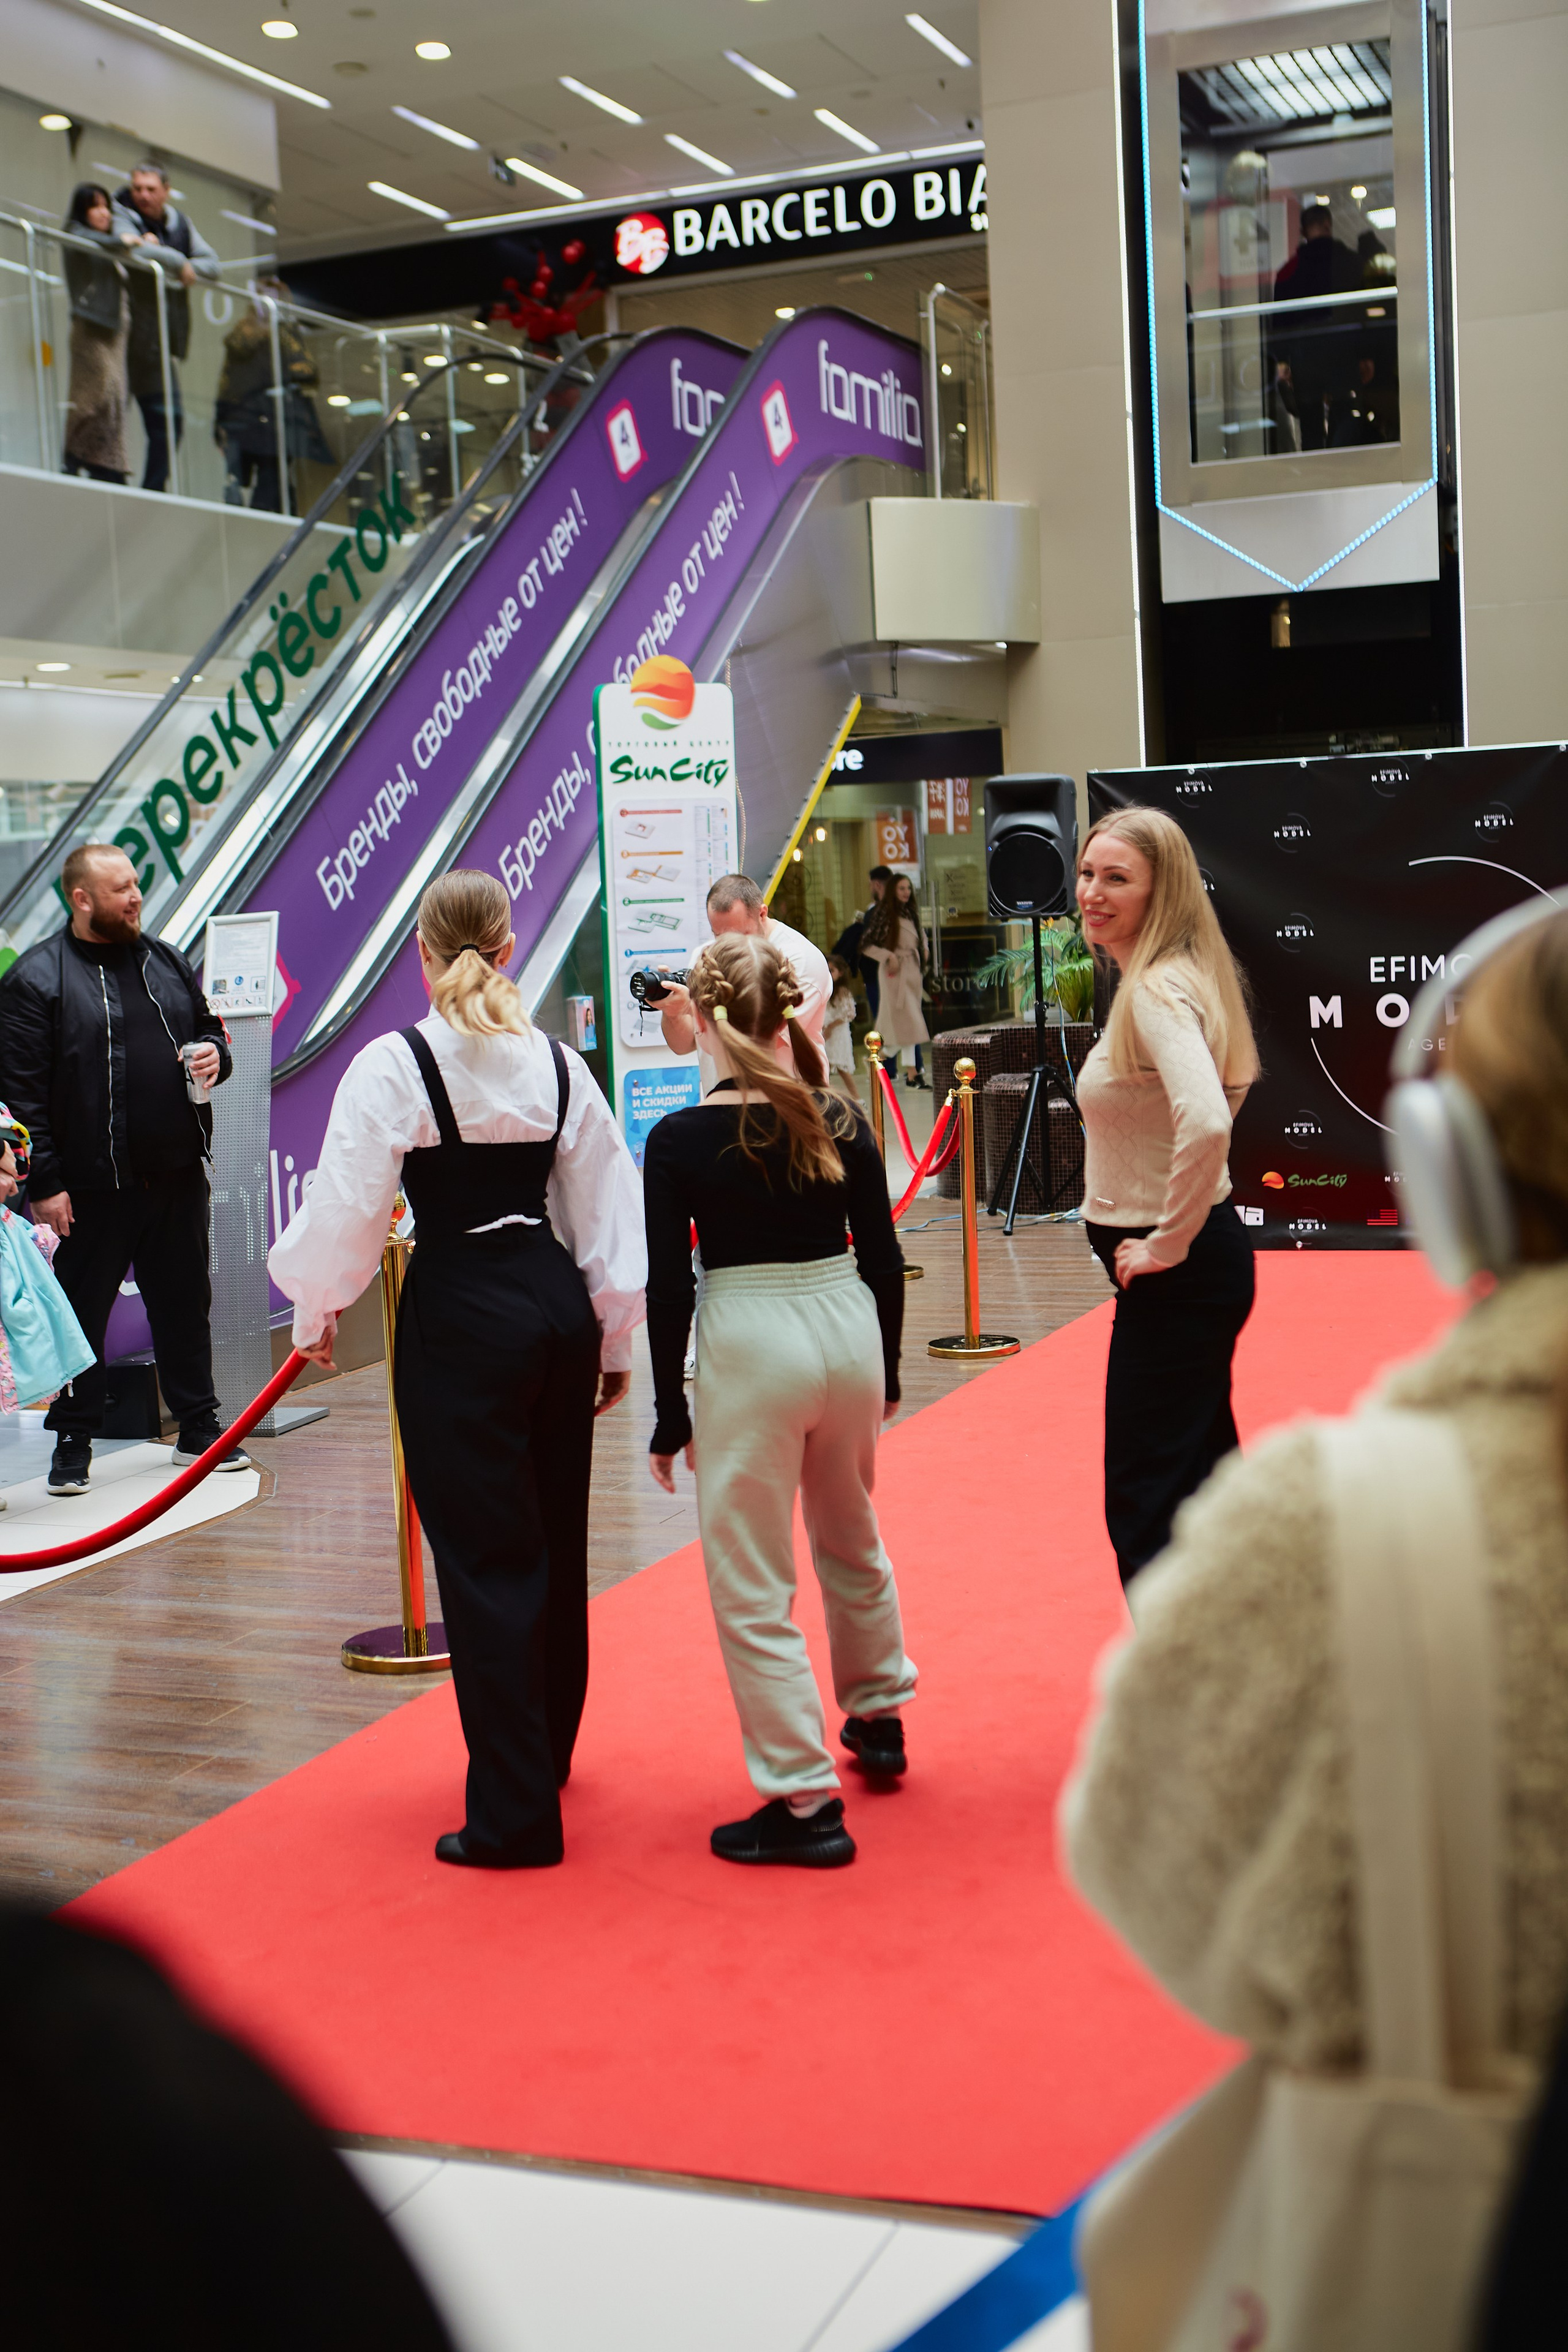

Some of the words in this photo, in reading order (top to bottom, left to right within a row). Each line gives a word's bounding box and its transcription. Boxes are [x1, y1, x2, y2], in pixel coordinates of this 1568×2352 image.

[673, 179, 895, 256] BARCELO
[818, 339, 923, 448] familia
[53, 469, 416, 917] ерекрёсток
[315, 763, 419, 911] Бренды,
[412, 597, 522, 770] свободные
[518, 557, 544, 609] от
[540, 488, 588, 576] цен!
[498, 750, 592, 901] Бренды,
[682, 541, 706, 594] от
[701, 470, 745, 560] цен!
[609, 755, 729, 788] SunCity
[831, 743, 865, 771] re
[632, 1087, 653, 1096] ВСЕ
[655, 1084, 693, 1095] АКЦИИ
[632, 1099, 641, 1107] И
[643, 1096, 687, 1107] СКИДКИ
[633, 1109, 668, 1120] ЗДЕСЬ
[1287, 1174, 1348, 1188] SunCity
